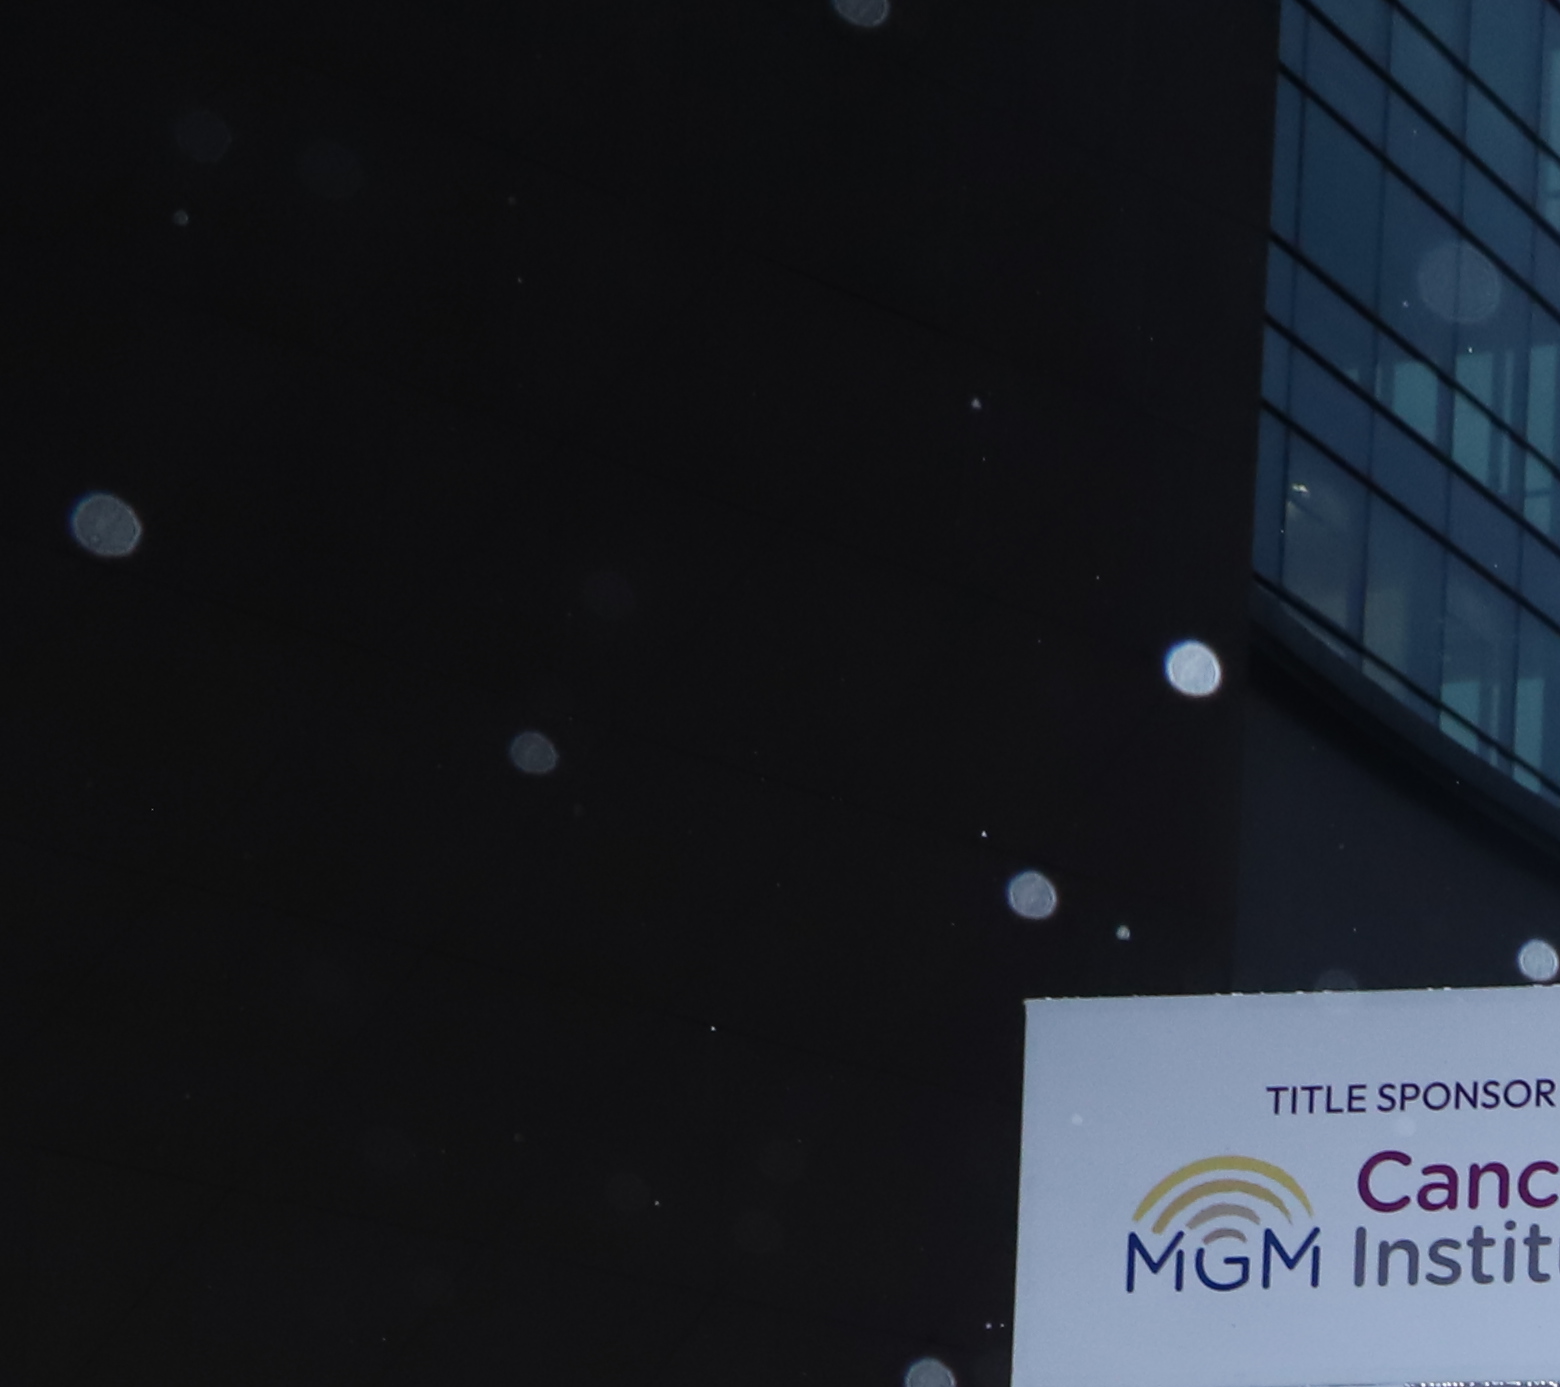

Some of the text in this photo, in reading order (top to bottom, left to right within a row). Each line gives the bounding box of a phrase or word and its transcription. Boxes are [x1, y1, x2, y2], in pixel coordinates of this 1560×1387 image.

[1267, 1079, 1557, 1115] TITLE SPONSOR
[1126, 1227, 1321, 1293] MGM
